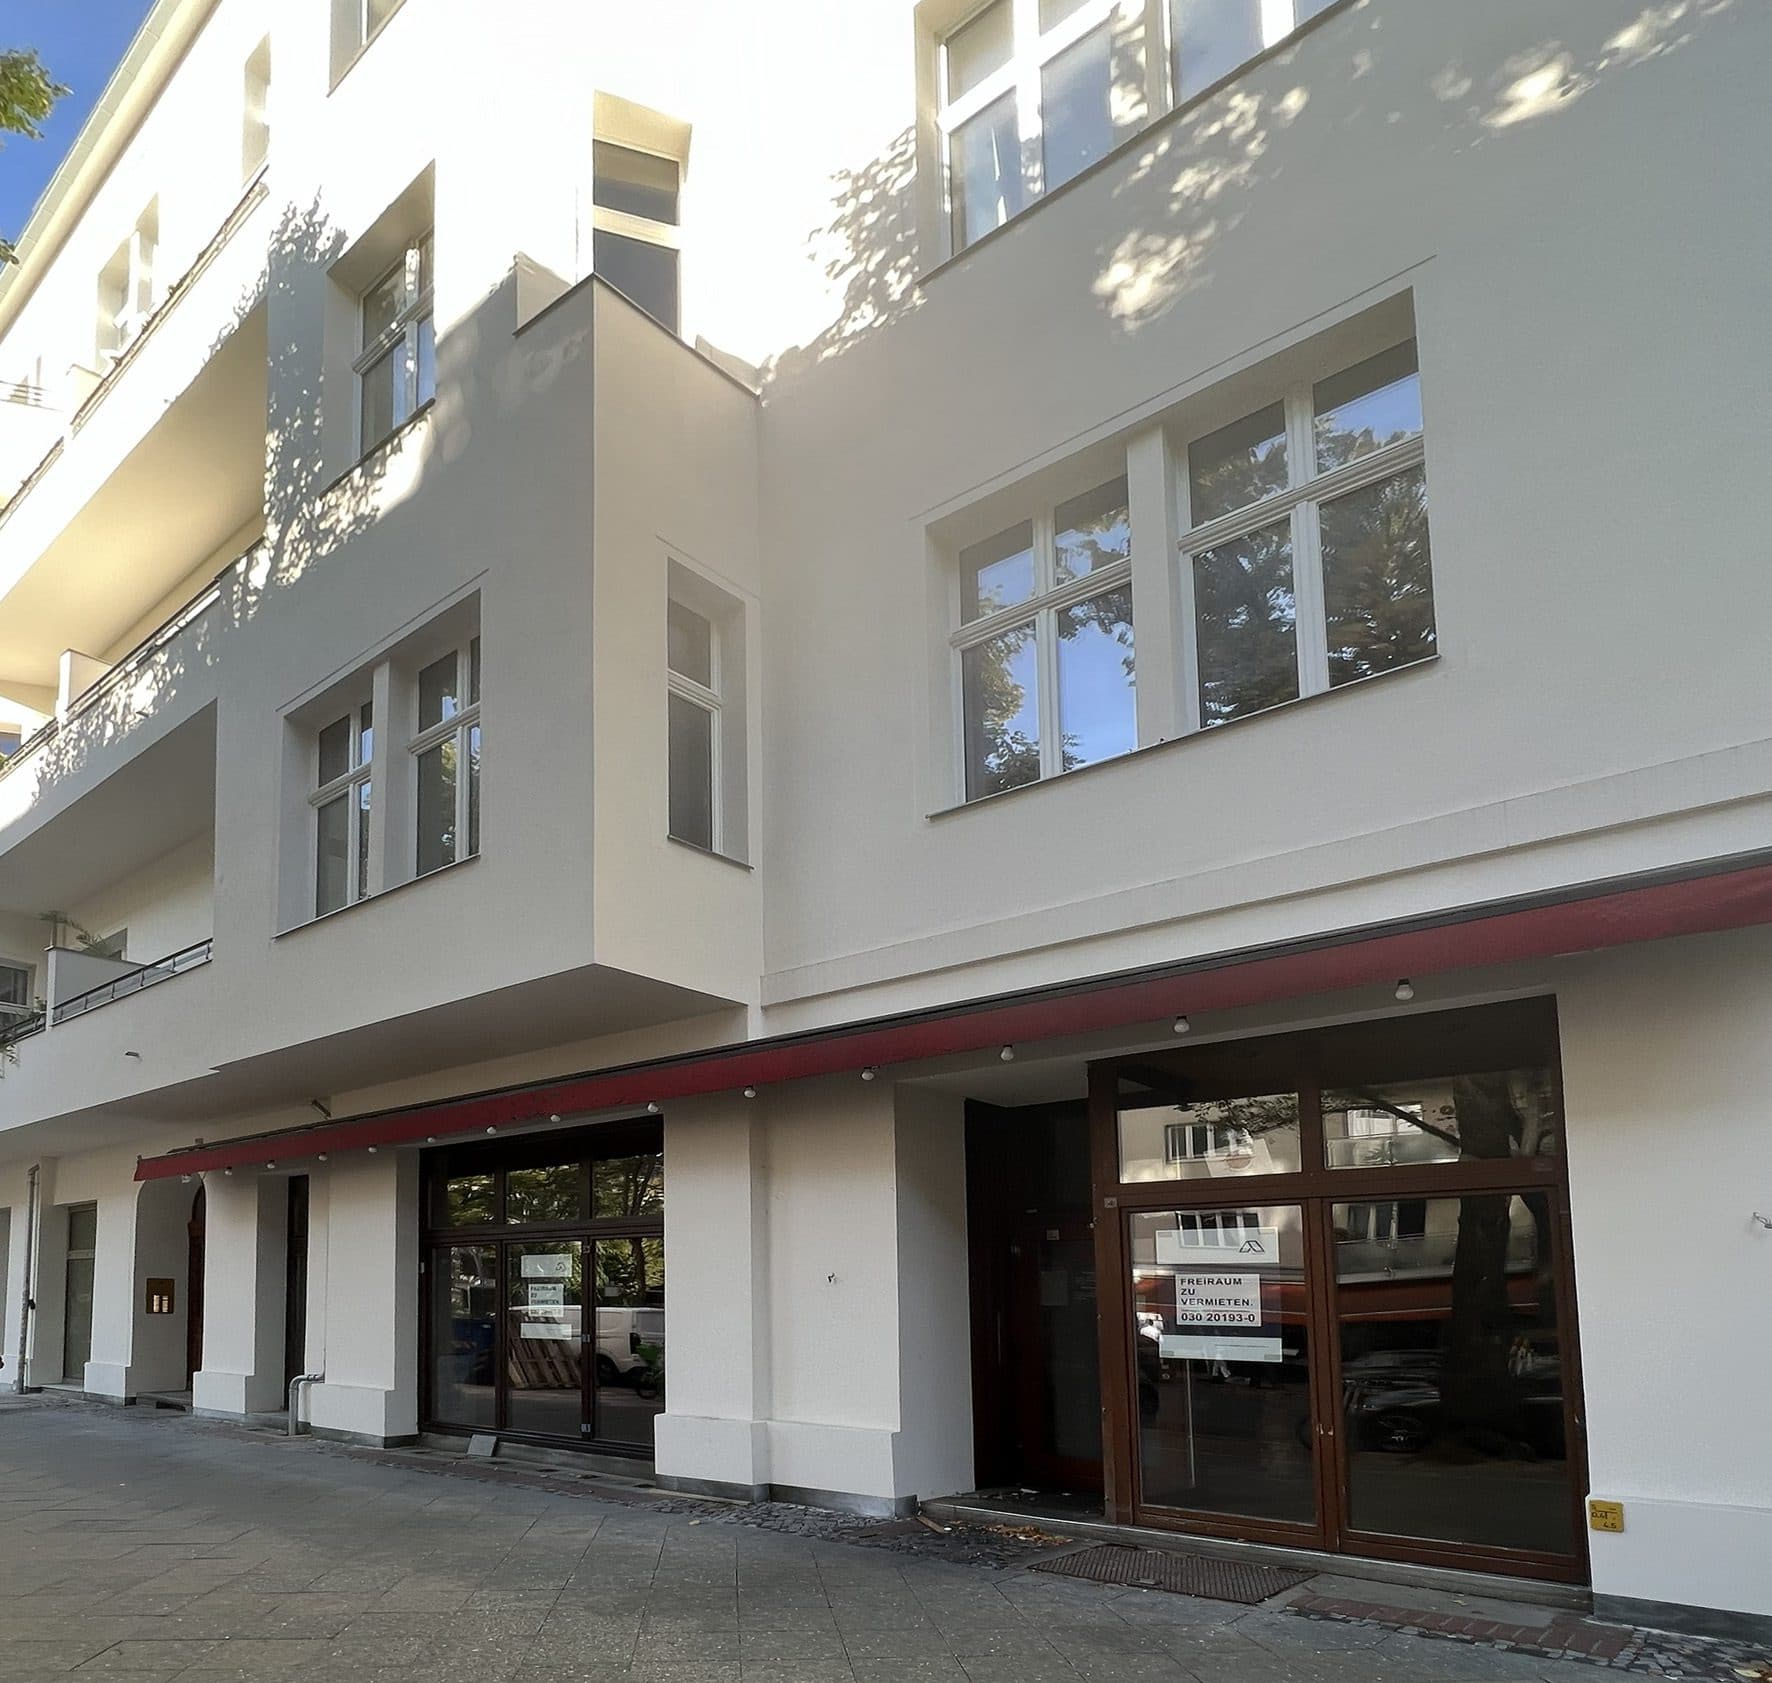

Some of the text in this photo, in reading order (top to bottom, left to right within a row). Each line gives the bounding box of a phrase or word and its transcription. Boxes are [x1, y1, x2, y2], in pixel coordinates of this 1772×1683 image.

[1181, 1278, 1242, 1286] FREIRAUM
[1181, 1288, 1195, 1296] ZU
[1181, 1298, 1253, 1306] VERMIETEN.
[1181, 1312, 1255, 1323] 030 20193-0
